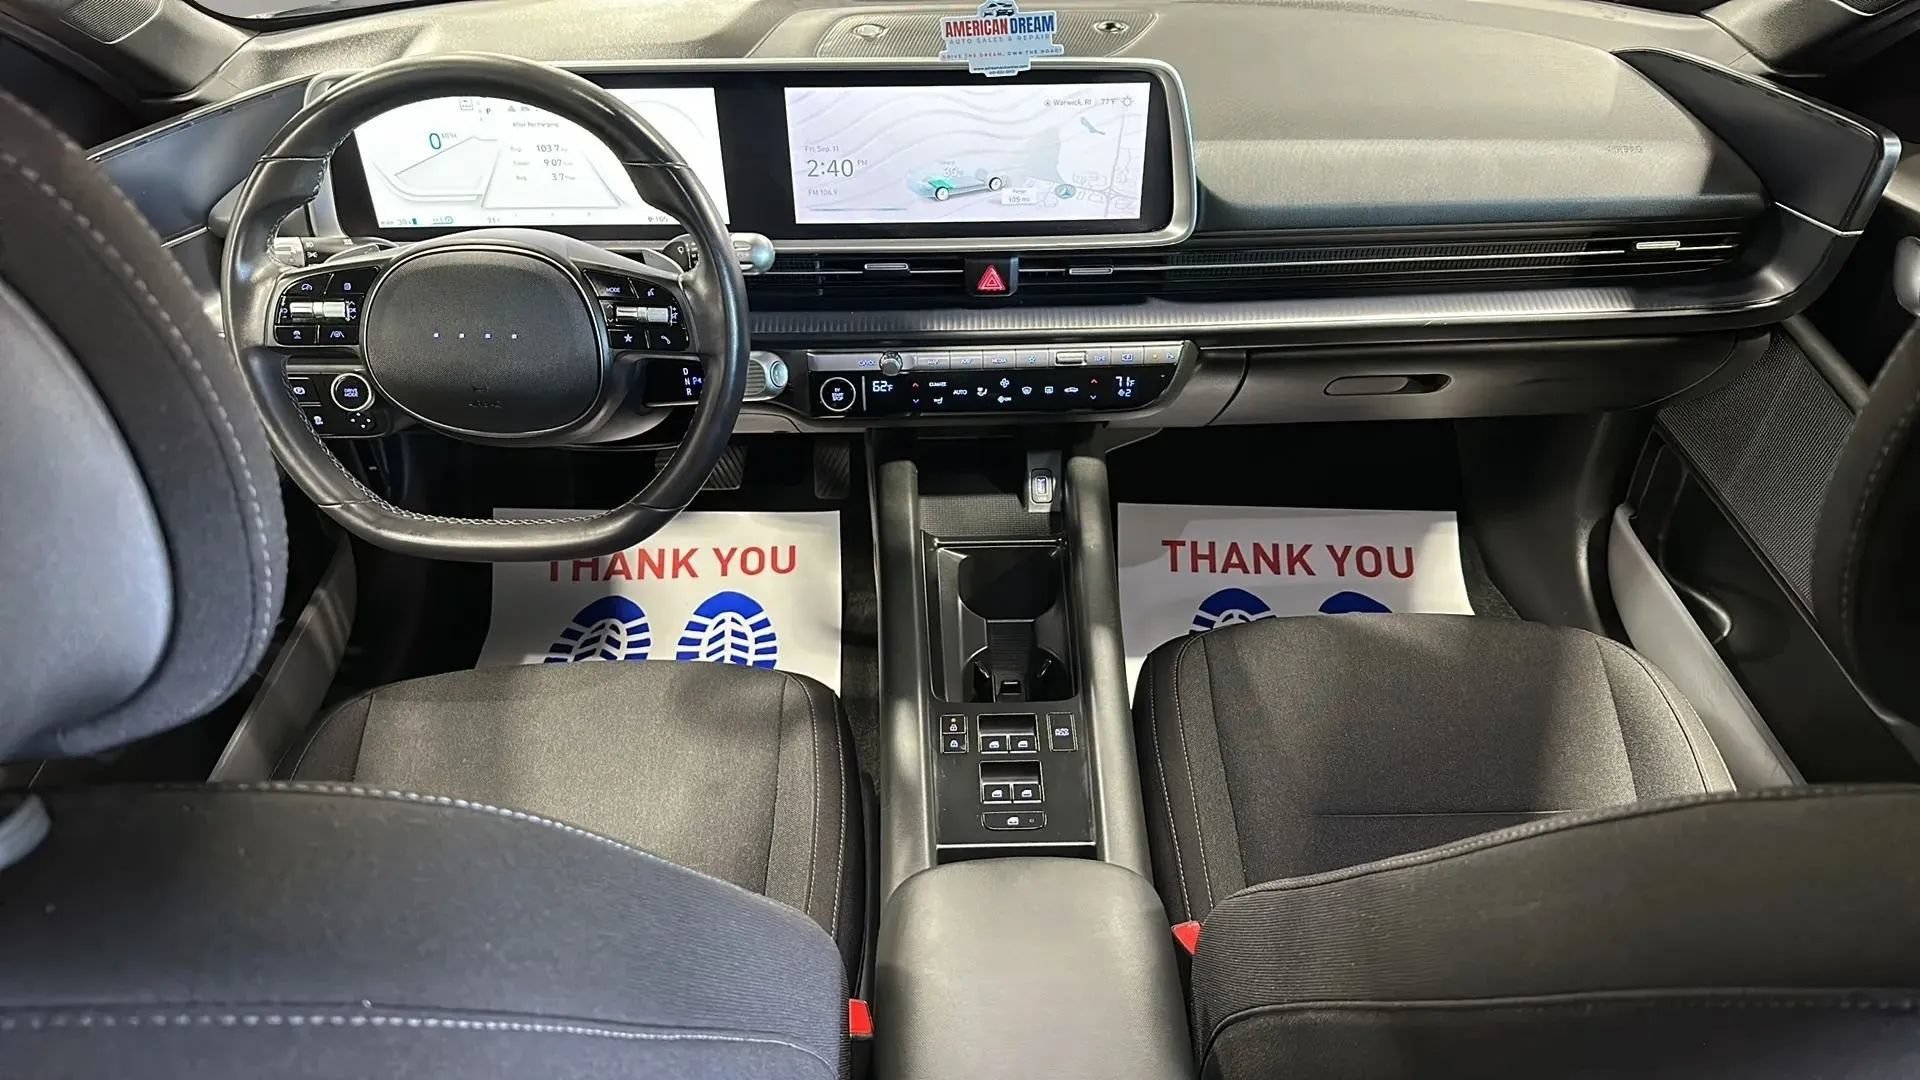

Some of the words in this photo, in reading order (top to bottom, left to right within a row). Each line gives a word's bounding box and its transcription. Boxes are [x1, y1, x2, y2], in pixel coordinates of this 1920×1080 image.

[945, 19, 1008, 38] AMERICAN
[1010, 15, 1055, 34] DREAM
[1018, 33, 1054, 41] REPAIR
[429, 132, 442, 150] 0
[806, 159, 854, 178] 2:40
[682, 367, 689, 376] D
[684, 377, 691, 386] N
[686, 387, 693, 396] R
[1125, 388, 1132, 397] 2
[712, 545, 797, 577] YOU
[1161, 540, 1317, 577] THANK
[1325, 544, 1416, 579] YOU
